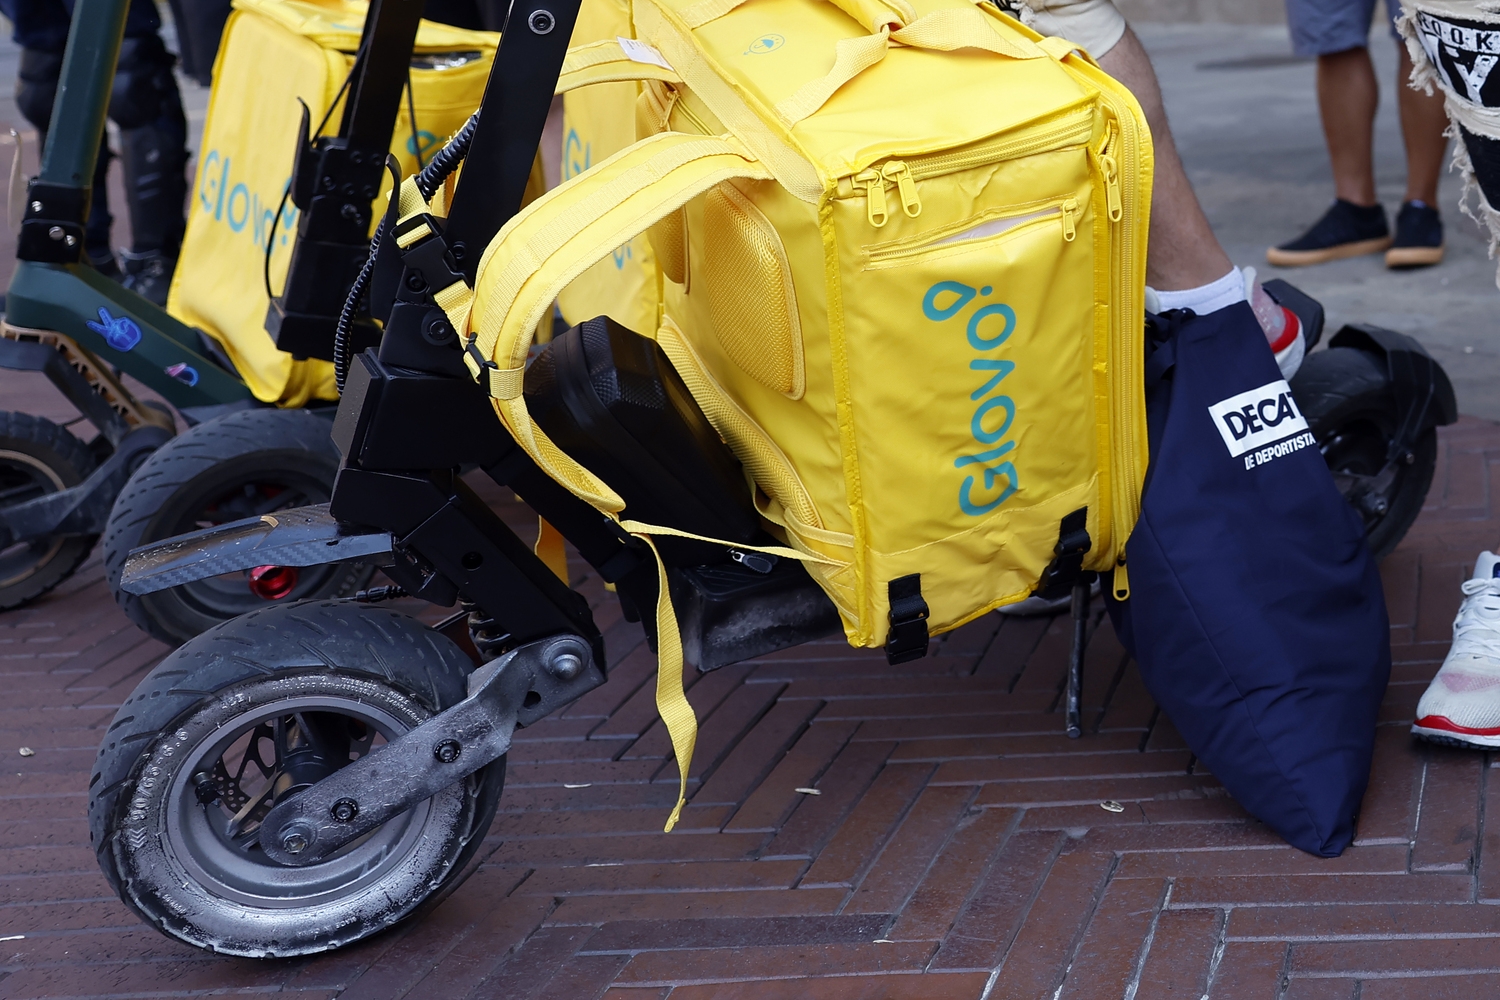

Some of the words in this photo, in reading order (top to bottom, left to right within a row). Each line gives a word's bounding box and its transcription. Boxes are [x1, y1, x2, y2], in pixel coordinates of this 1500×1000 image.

[954, 302, 1018, 516] Glovo
[1222, 392, 1297, 441] DECA
[1255, 432, 1316, 465] DEPORTISTA
